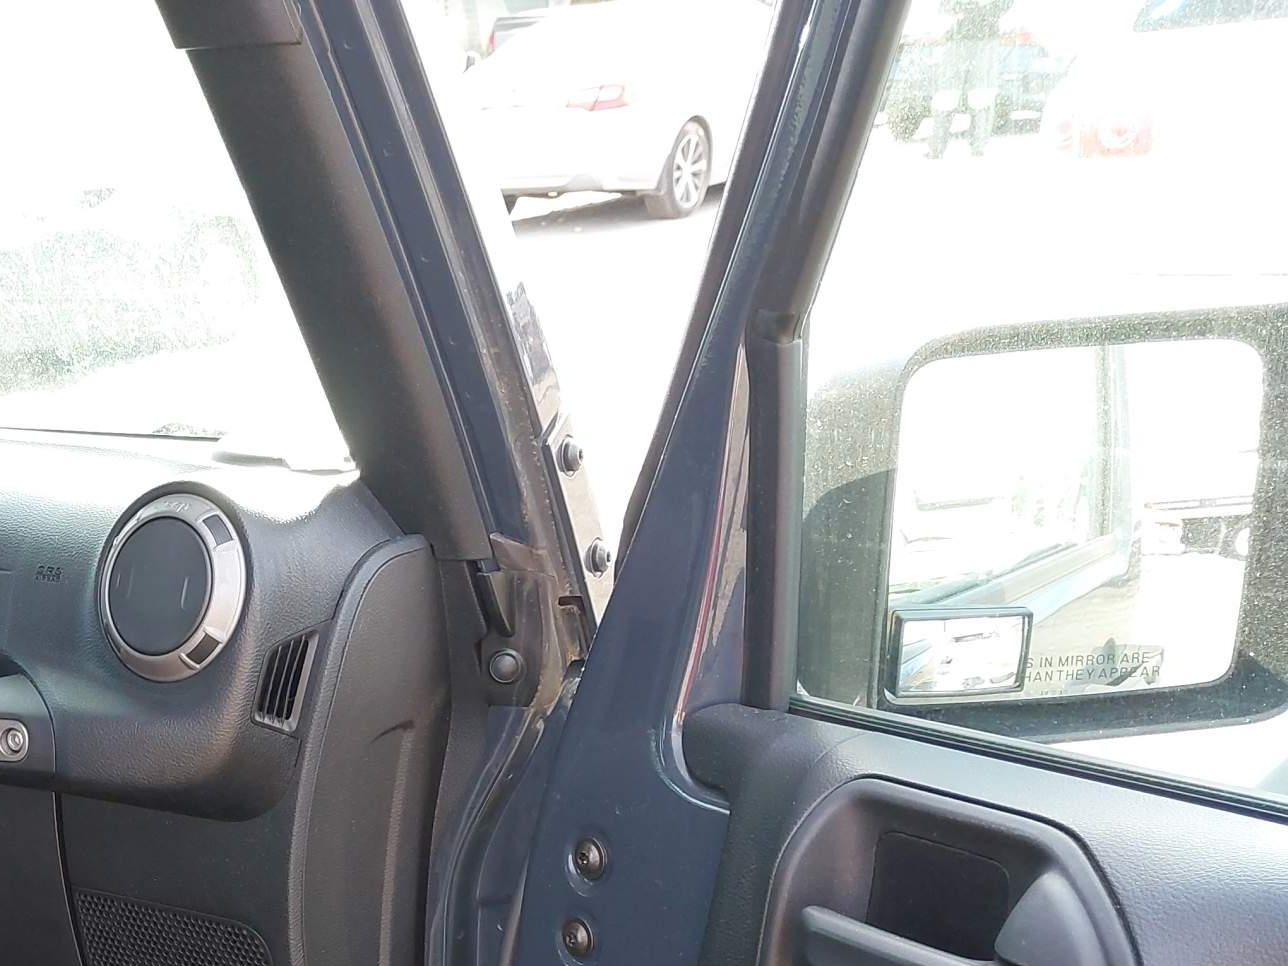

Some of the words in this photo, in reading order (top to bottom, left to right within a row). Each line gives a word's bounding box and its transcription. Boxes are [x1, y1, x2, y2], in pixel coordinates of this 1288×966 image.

[1039, 656, 1053, 668] IN
[1058, 654, 1115, 668] MIRROR
[1120, 652, 1150, 665] ARE
[1024, 670, 1054, 683] HAN
[1057, 669, 1095, 681] THEY
[1098, 665, 1161, 679] APPEAR
